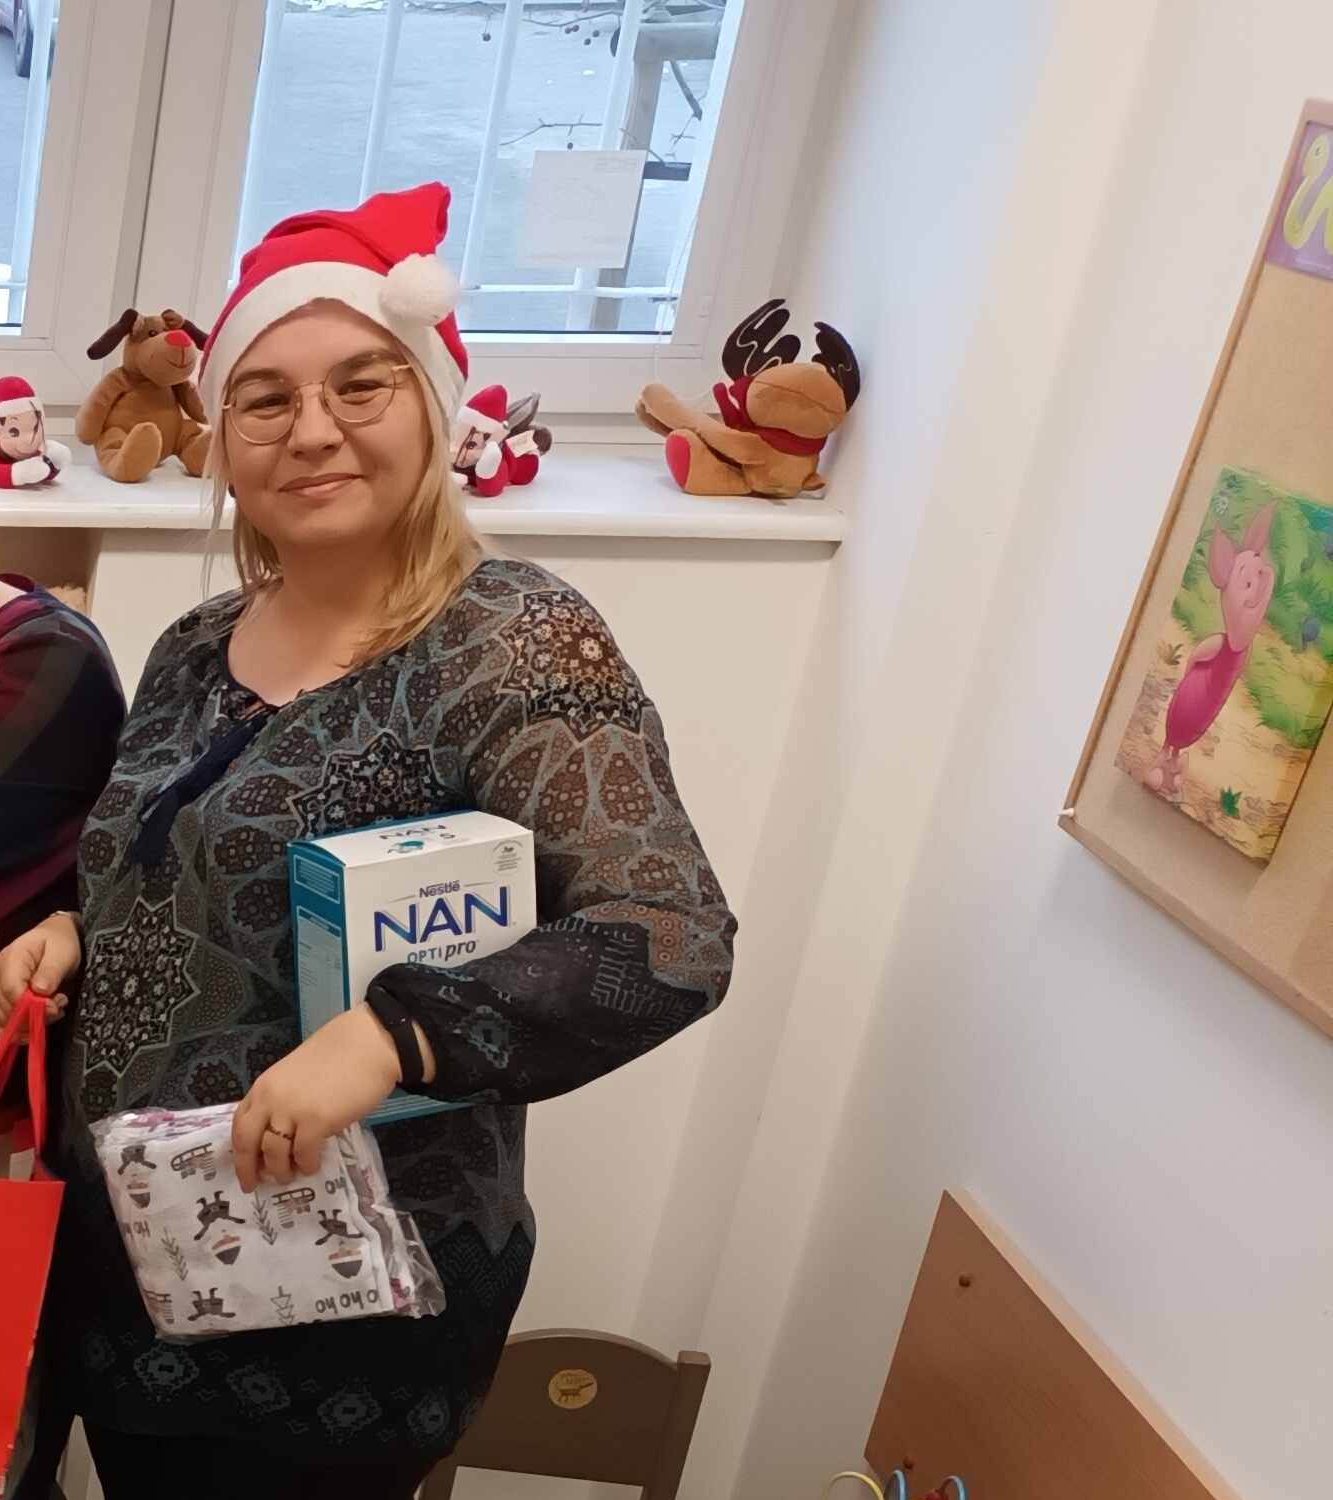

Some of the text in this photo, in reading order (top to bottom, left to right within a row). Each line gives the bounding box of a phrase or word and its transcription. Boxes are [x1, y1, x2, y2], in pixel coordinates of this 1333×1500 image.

[380, 824, 447, 840] NAN
[419, 880, 461, 898] Nestlé
[373, 885, 511, 952] NAN
